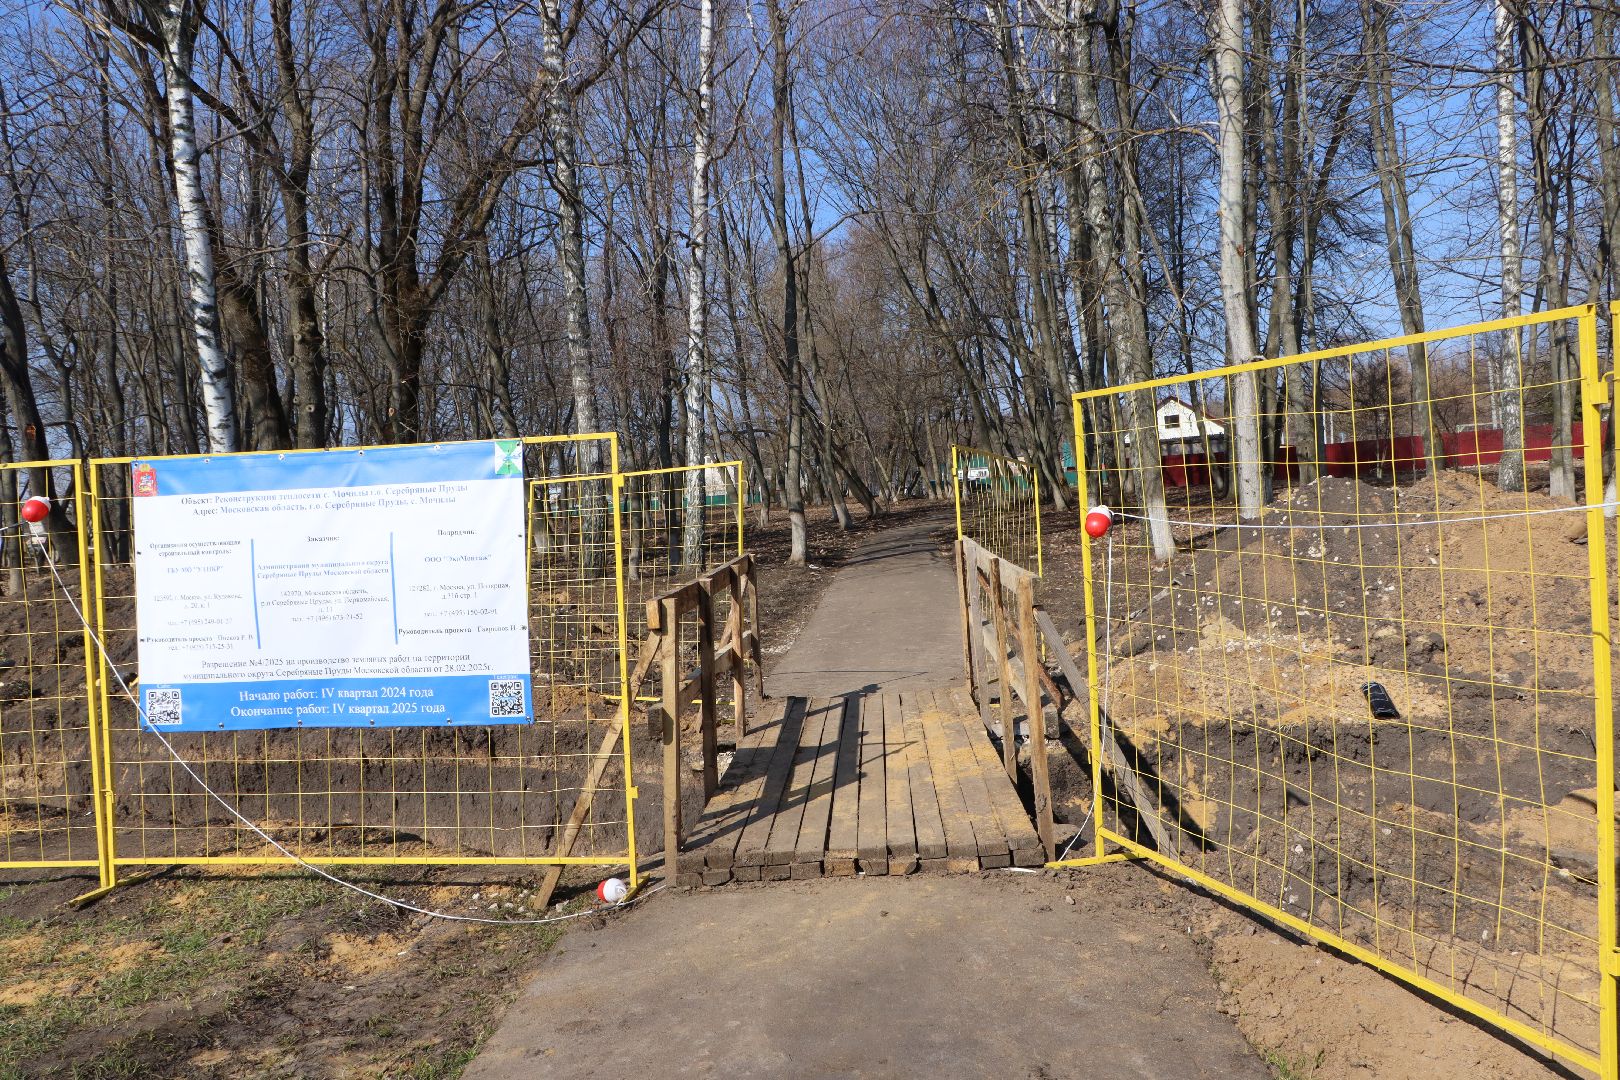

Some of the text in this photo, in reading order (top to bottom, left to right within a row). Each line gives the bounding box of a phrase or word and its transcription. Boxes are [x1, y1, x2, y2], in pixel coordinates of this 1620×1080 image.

[215, 494, 277, 503] Реконструкция
[385, 487, 436, 496] Серебряные
[439, 484, 469, 493] Пруды
[193, 508, 218, 517] Адрес:
[220, 505, 270, 514] Московская
[325, 500, 376, 510] Серебряные
[398, 628, 443, 636] Руководитель
[444, 627, 472, 635] проекта
[201, 660, 247, 669] Разрешение
[297, 657, 349, 667] производство
[389, 653, 410, 663] работ
[424, 653, 470, 663] территории
[183, 671, 246, 680] муниципального
[247, 670, 274, 679] округа
[275, 668, 323, 677] Серебряные
[324, 666, 352, 676] Пруды
[354, 665, 399, 674] Московской
[400, 664, 432, 673] области
[239, 686, 434, 702] Начало работ: IV квартал 2024 года
[230, 701, 446, 717] Окончание работ: IV квартал 2025 года
